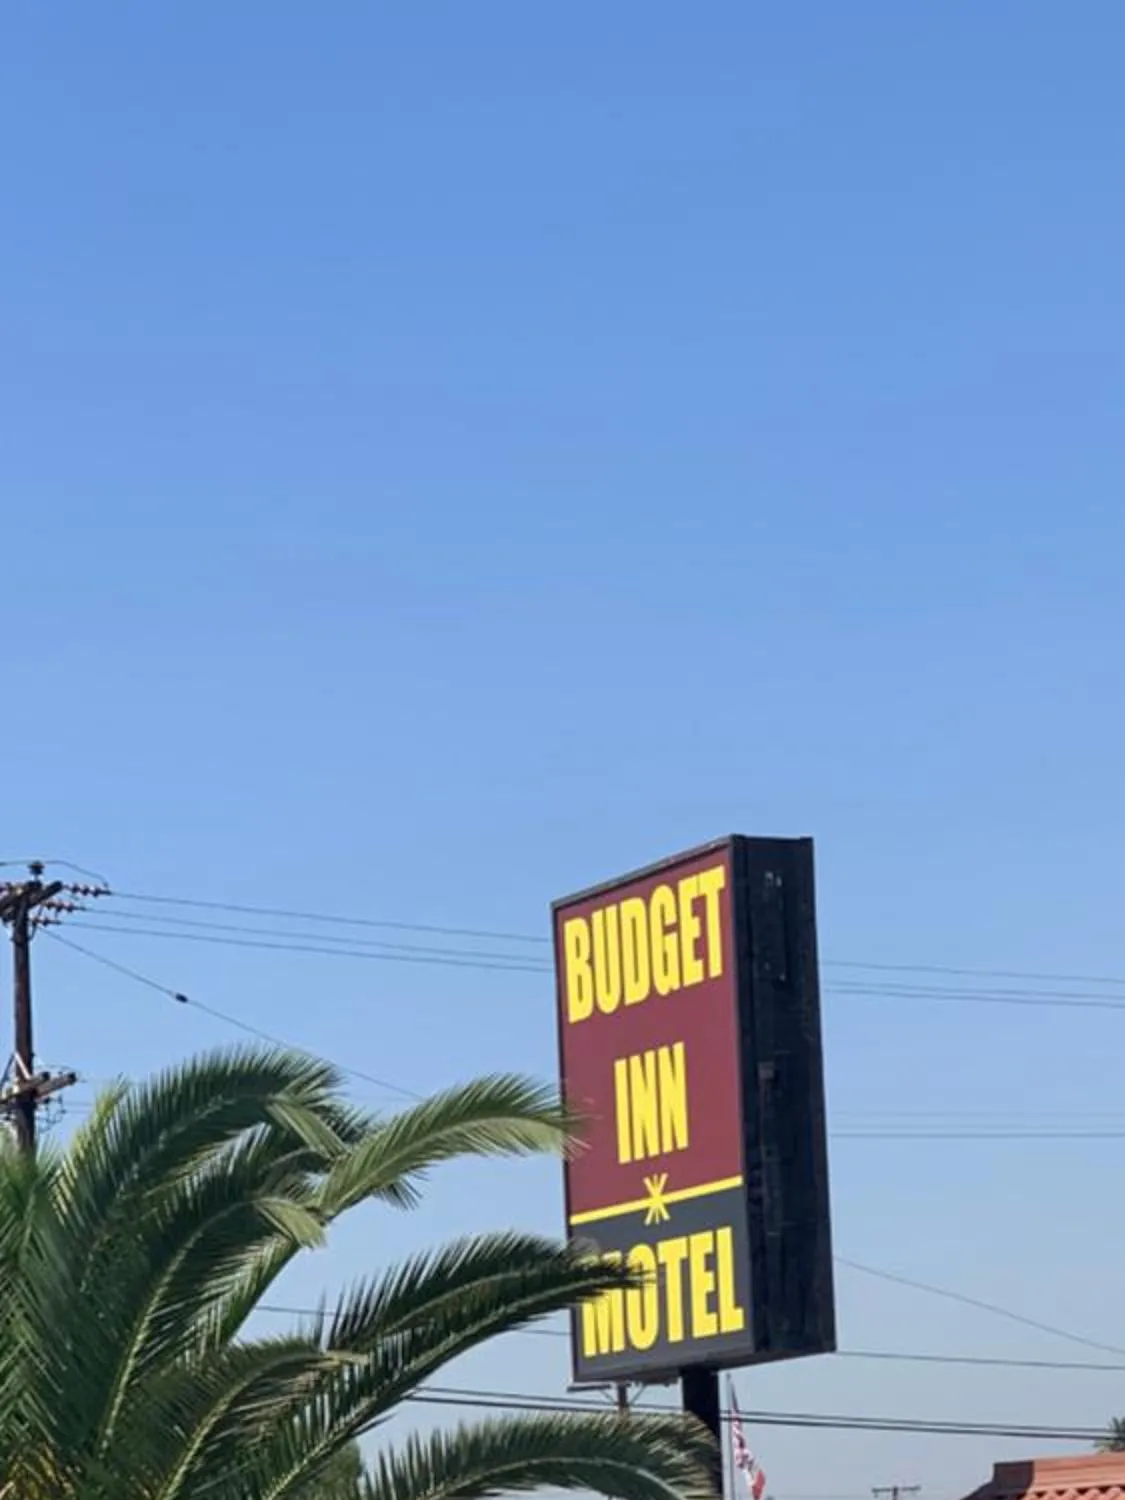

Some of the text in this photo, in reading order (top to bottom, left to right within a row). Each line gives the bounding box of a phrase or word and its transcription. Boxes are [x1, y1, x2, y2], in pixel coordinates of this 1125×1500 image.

[564, 865, 725, 1023] BUDGET
[614, 1041, 689, 1164] INN
[580, 1226, 744, 1357] MOTEL
